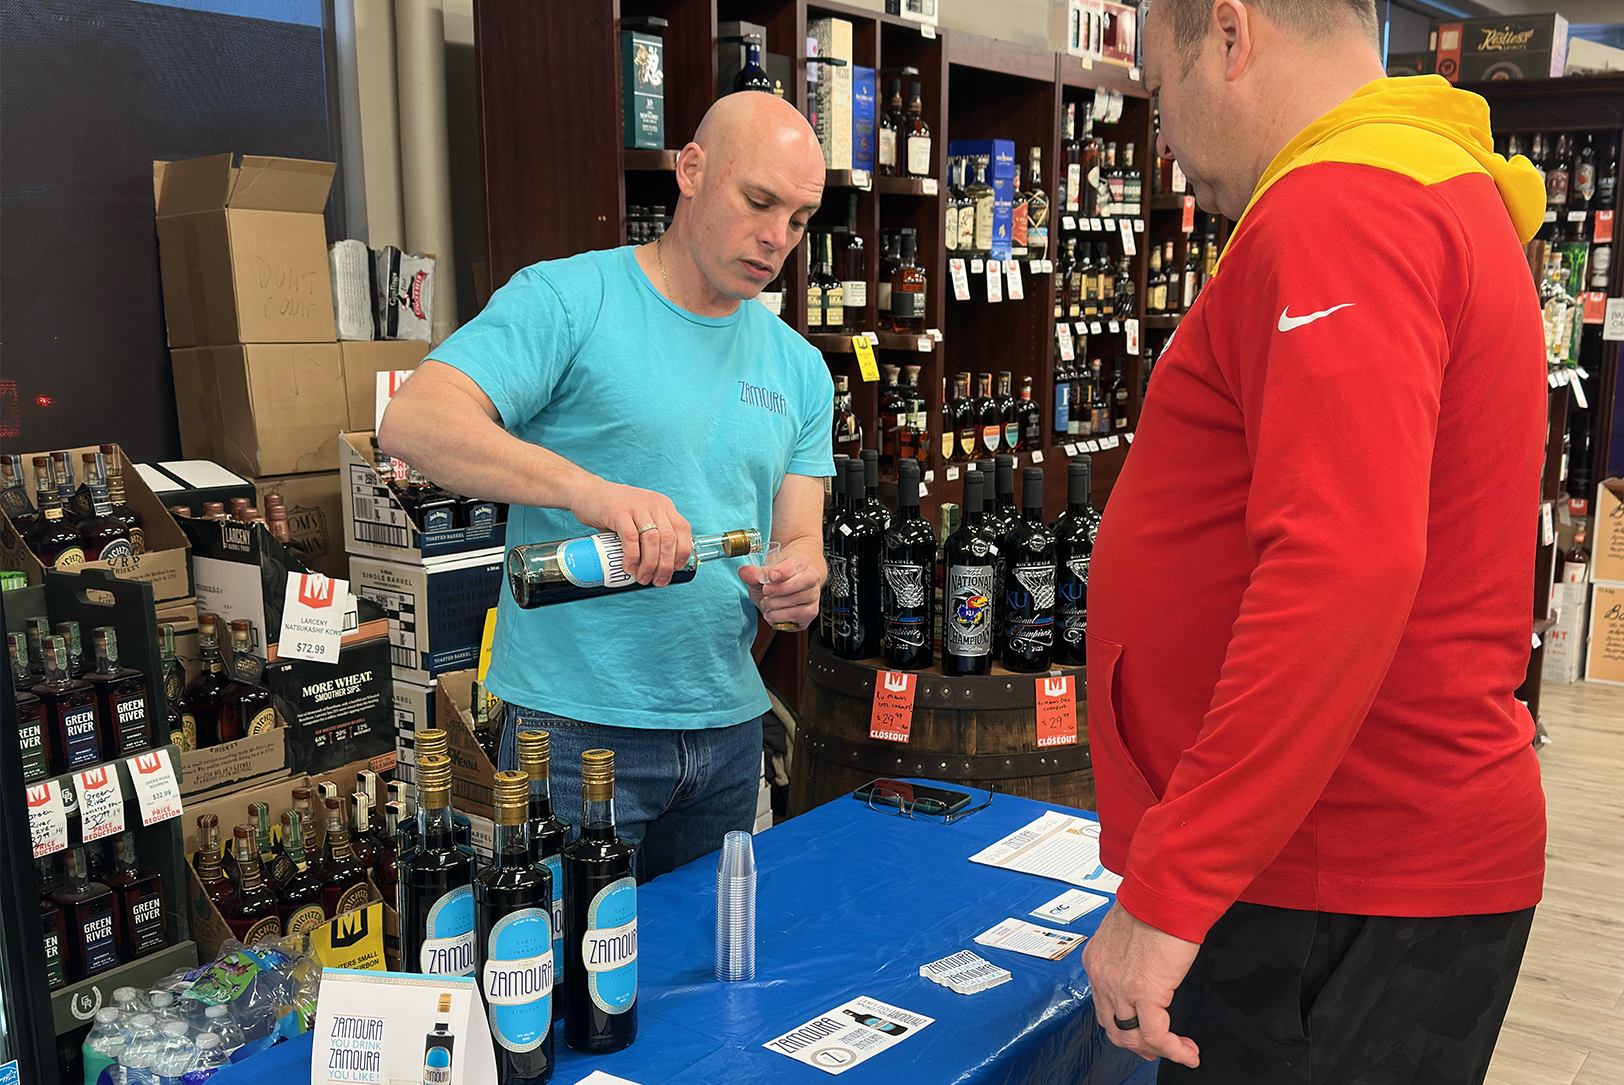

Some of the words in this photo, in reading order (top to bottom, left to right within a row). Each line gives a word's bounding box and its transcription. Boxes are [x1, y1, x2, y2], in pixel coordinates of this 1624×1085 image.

[738, 380, 787, 417] ZAMOURA
[225, 527, 250, 545] LARCENY
[425, 534, 447, 542] TOASTED
[447, 532, 464, 540] BARREL
[362, 571, 385, 582] SINGLE
[386, 575, 413, 587] BARREL
[951, 574, 992, 592] NATIONAL
[1006, 589, 1028, 610] KU
[1058, 583, 1083, 602] KU
[301, 617, 328, 627] LARCENY
[325, 628, 342, 637] KCWS
[297, 643, 325, 654] $72.99
[434, 653, 454, 664] TOASTED
[454, 651, 471, 660] BARREL
[302, 679, 334, 698] MORE
[334, 671, 373, 690] WHEAT.
[314, 690, 348, 704] SMOOTHER
[117, 698, 145, 714] GREEN
[65, 710, 94, 726] GREEN
[119, 709, 145, 724] RIVER
[252, 713, 274, 735] MICHT
[67, 721, 95, 737] RIVER
[870, 729, 909, 742] CLOSEOUT
[20, 736, 42, 750] IVER
[1038, 735, 1077, 746] CLOSEOUT
[83, 787, 116, 801] Green
[152, 789, 172, 800] $32.99
[86, 795, 112, 809] River
[144, 809, 181, 825] REDUCTION
[151, 805, 171, 816] PRICE
[84, 825, 122, 842] REDUCTION
[93, 822, 113, 833] PRICE
[471, 831, 492, 842] ARREL
[34, 840, 56, 851] PRICE
[34, 843, 66, 858] DUCTION
[132, 898, 161, 915] GREEN
[134, 908, 161, 924] RIVER
[84, 916, 112, 934] GREEN
[86, 926, 113, 943] RIVER
[516, 938, 537, 946] CLOVE
[357, 951, 379, 962] SMALL
[508, 945, 543, 955] CINNAMON
[923, 951, 980, 974] ZAMOURA
[490, 960, 552, 997] ZAMOURA
[944, 964, 1002, 984] ZAMOURA
[511, 1006, 540, 1015] LIQUEUR
[331, 1016, 383, 1041] ZAMOURA
[770, 1017, 847, 1054] ZAMOURA
[330, 1038, 350, 1048] YOU
[352, 1040, 382, 1051] DRINK
[329, 1048, 380, 1072] ZAMOURA
[821, 1052, 847, 1064] Z
[328, 1069, 349, 1079] YOU
[352, 1071, 380, 1083] LIKE!
[425, 1069, 450, 1083] ZAMOURA
